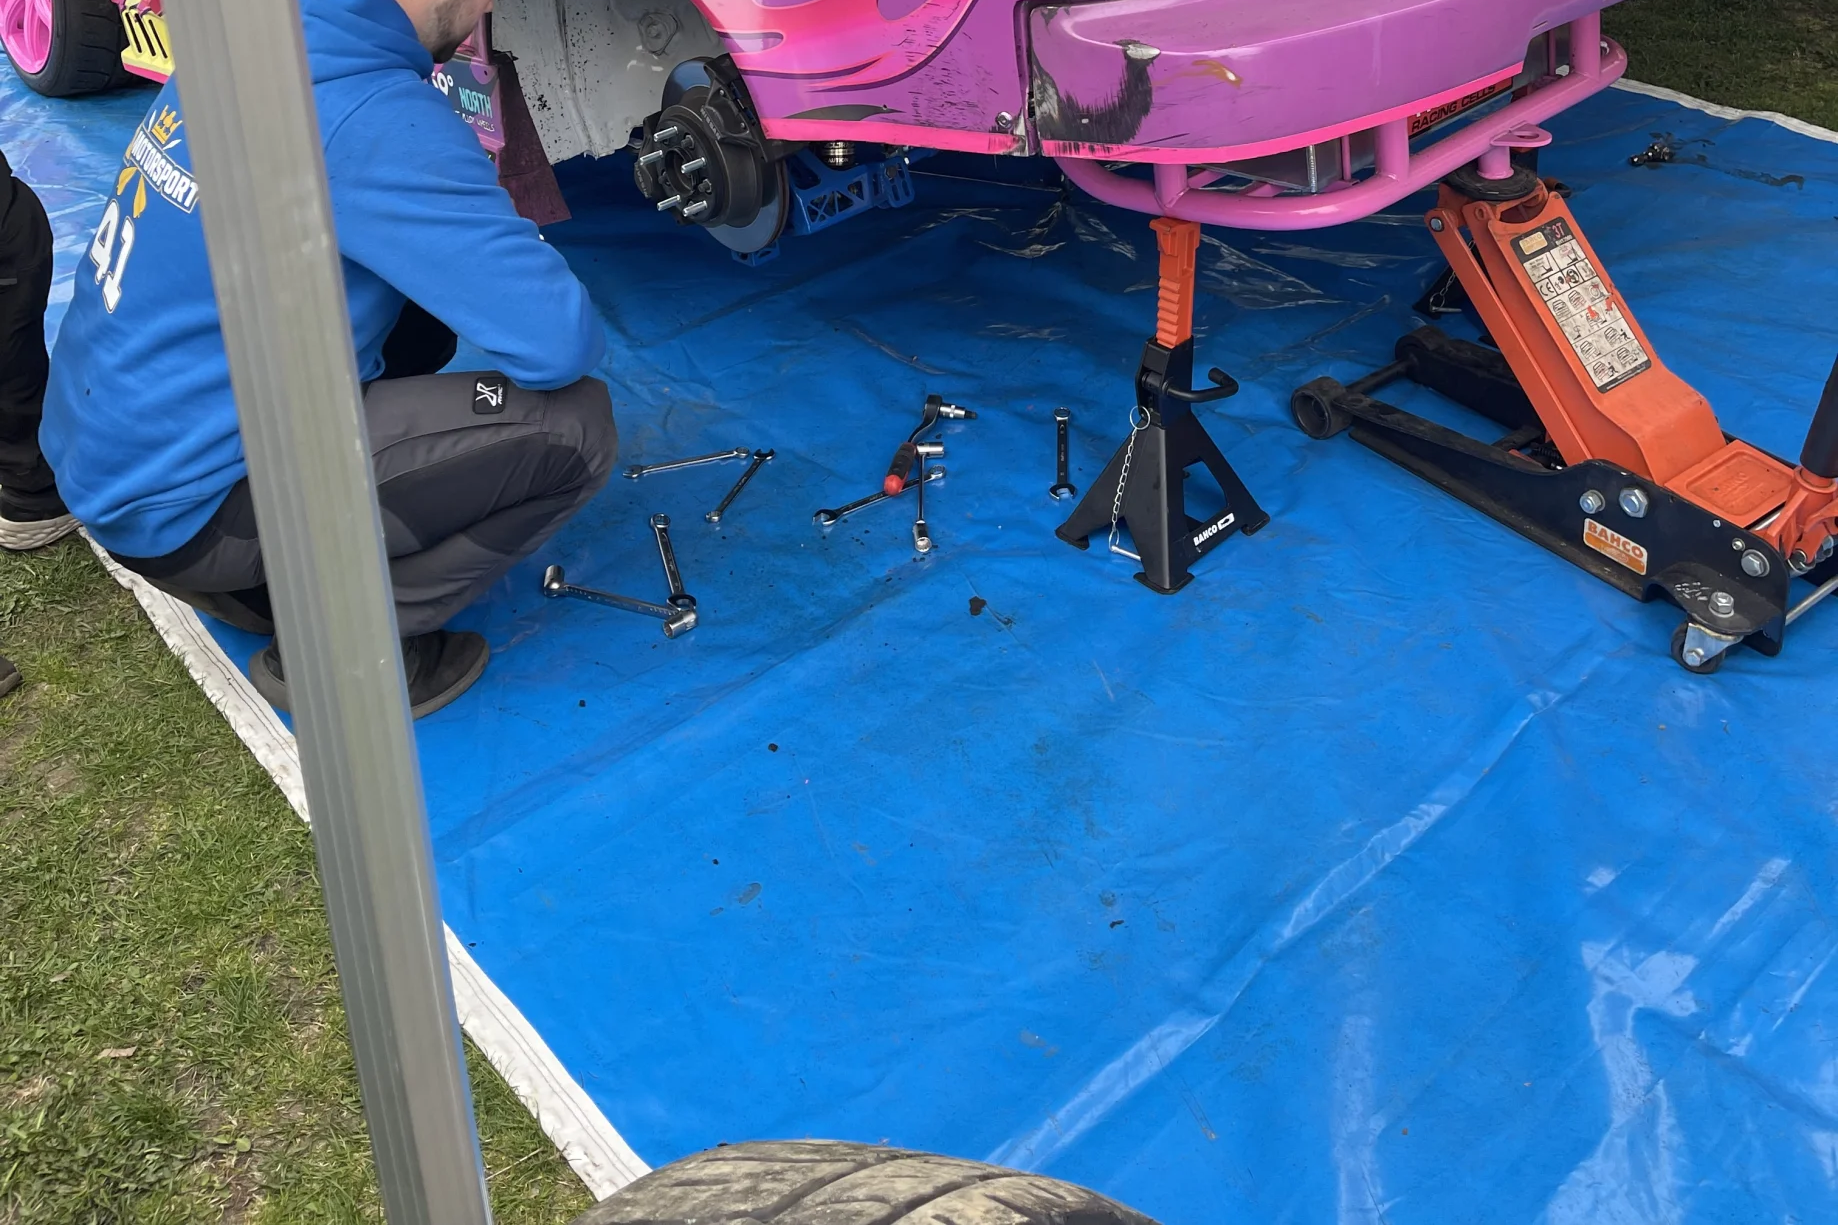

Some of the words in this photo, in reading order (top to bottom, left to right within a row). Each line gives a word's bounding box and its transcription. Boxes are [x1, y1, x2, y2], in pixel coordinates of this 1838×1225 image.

[1411, 102, 1457, 133] RACING
[131, 130, 200, 208] MOTORSPORT
[89, 199, 135, 313] 41
[1193, 524, 1218, 546] BAHCO
[1588, 521, 1644, 559] BAHCO
